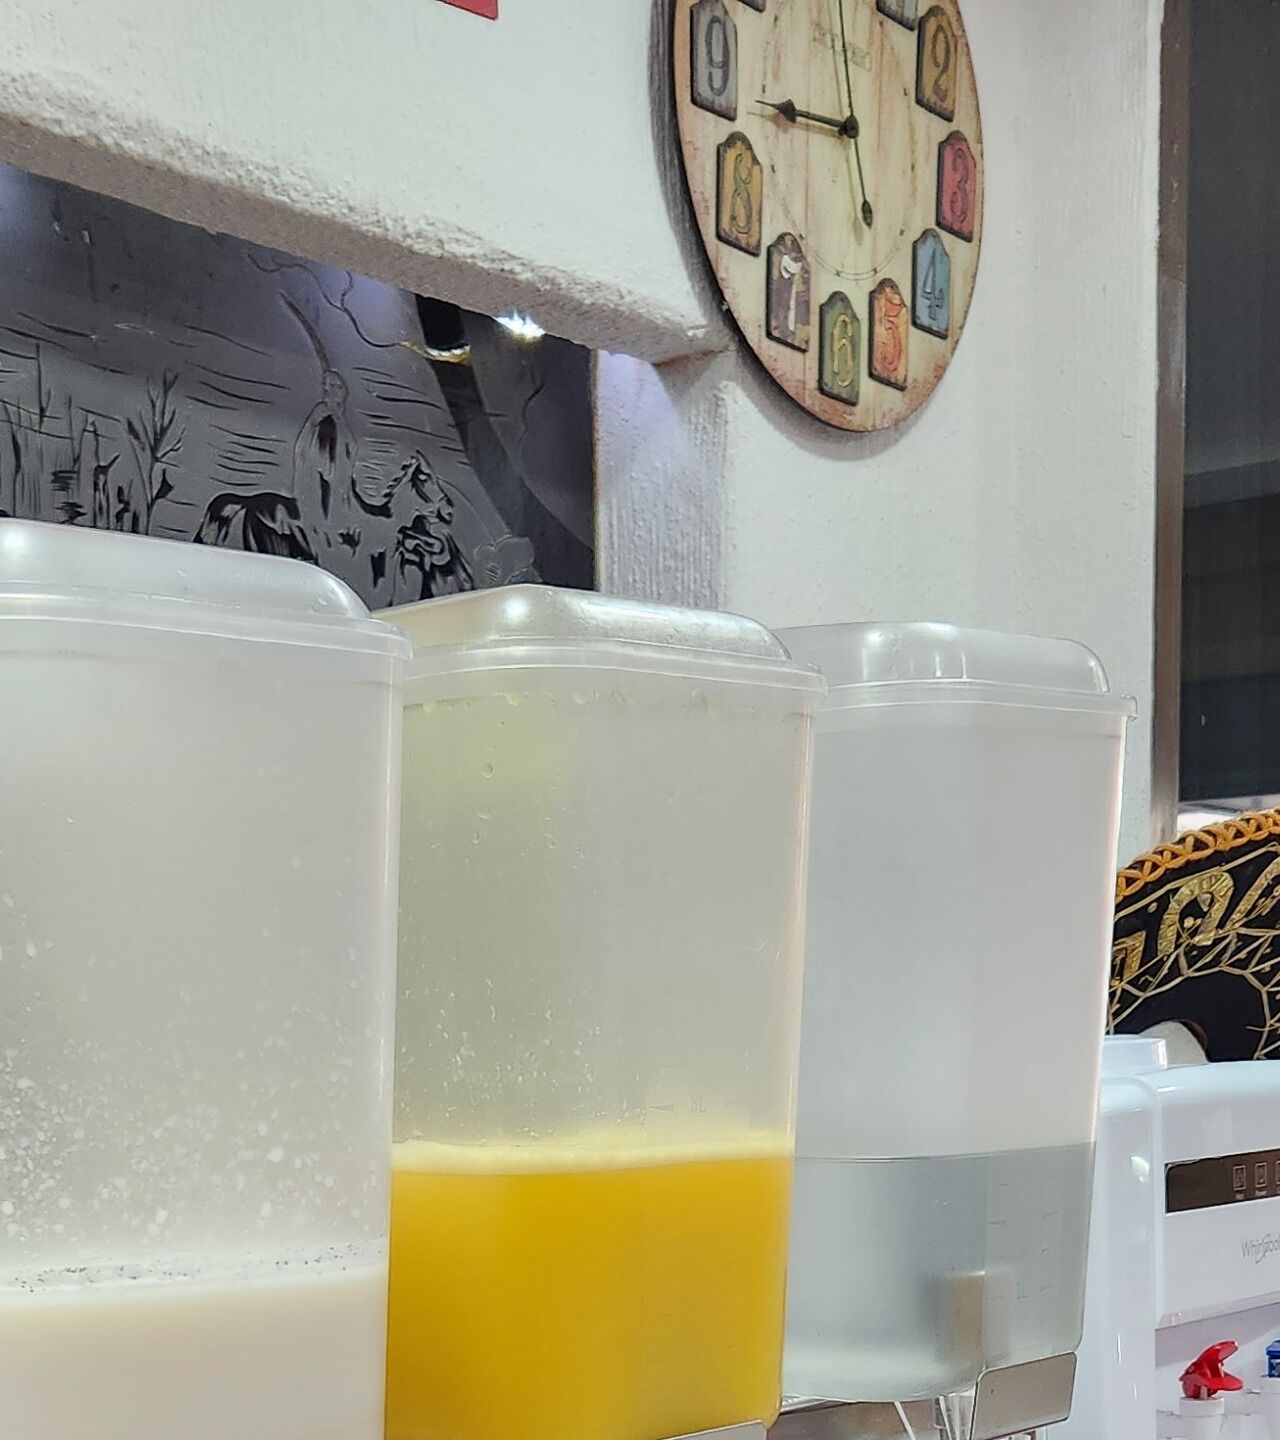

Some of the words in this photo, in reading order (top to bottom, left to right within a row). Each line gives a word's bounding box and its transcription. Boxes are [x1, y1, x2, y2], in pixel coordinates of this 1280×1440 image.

[705, 15, 730, 97] 9
[931, 24, 951, 102] 2
[729, 152, 754, 235] 8
[950, 147, 968, 224] 3
[780, 254, 803, 333] 7
[920, 247, 945, 322] 4
[831, 311, 853, 389] 6
[882, 286, 903, 373] 5
